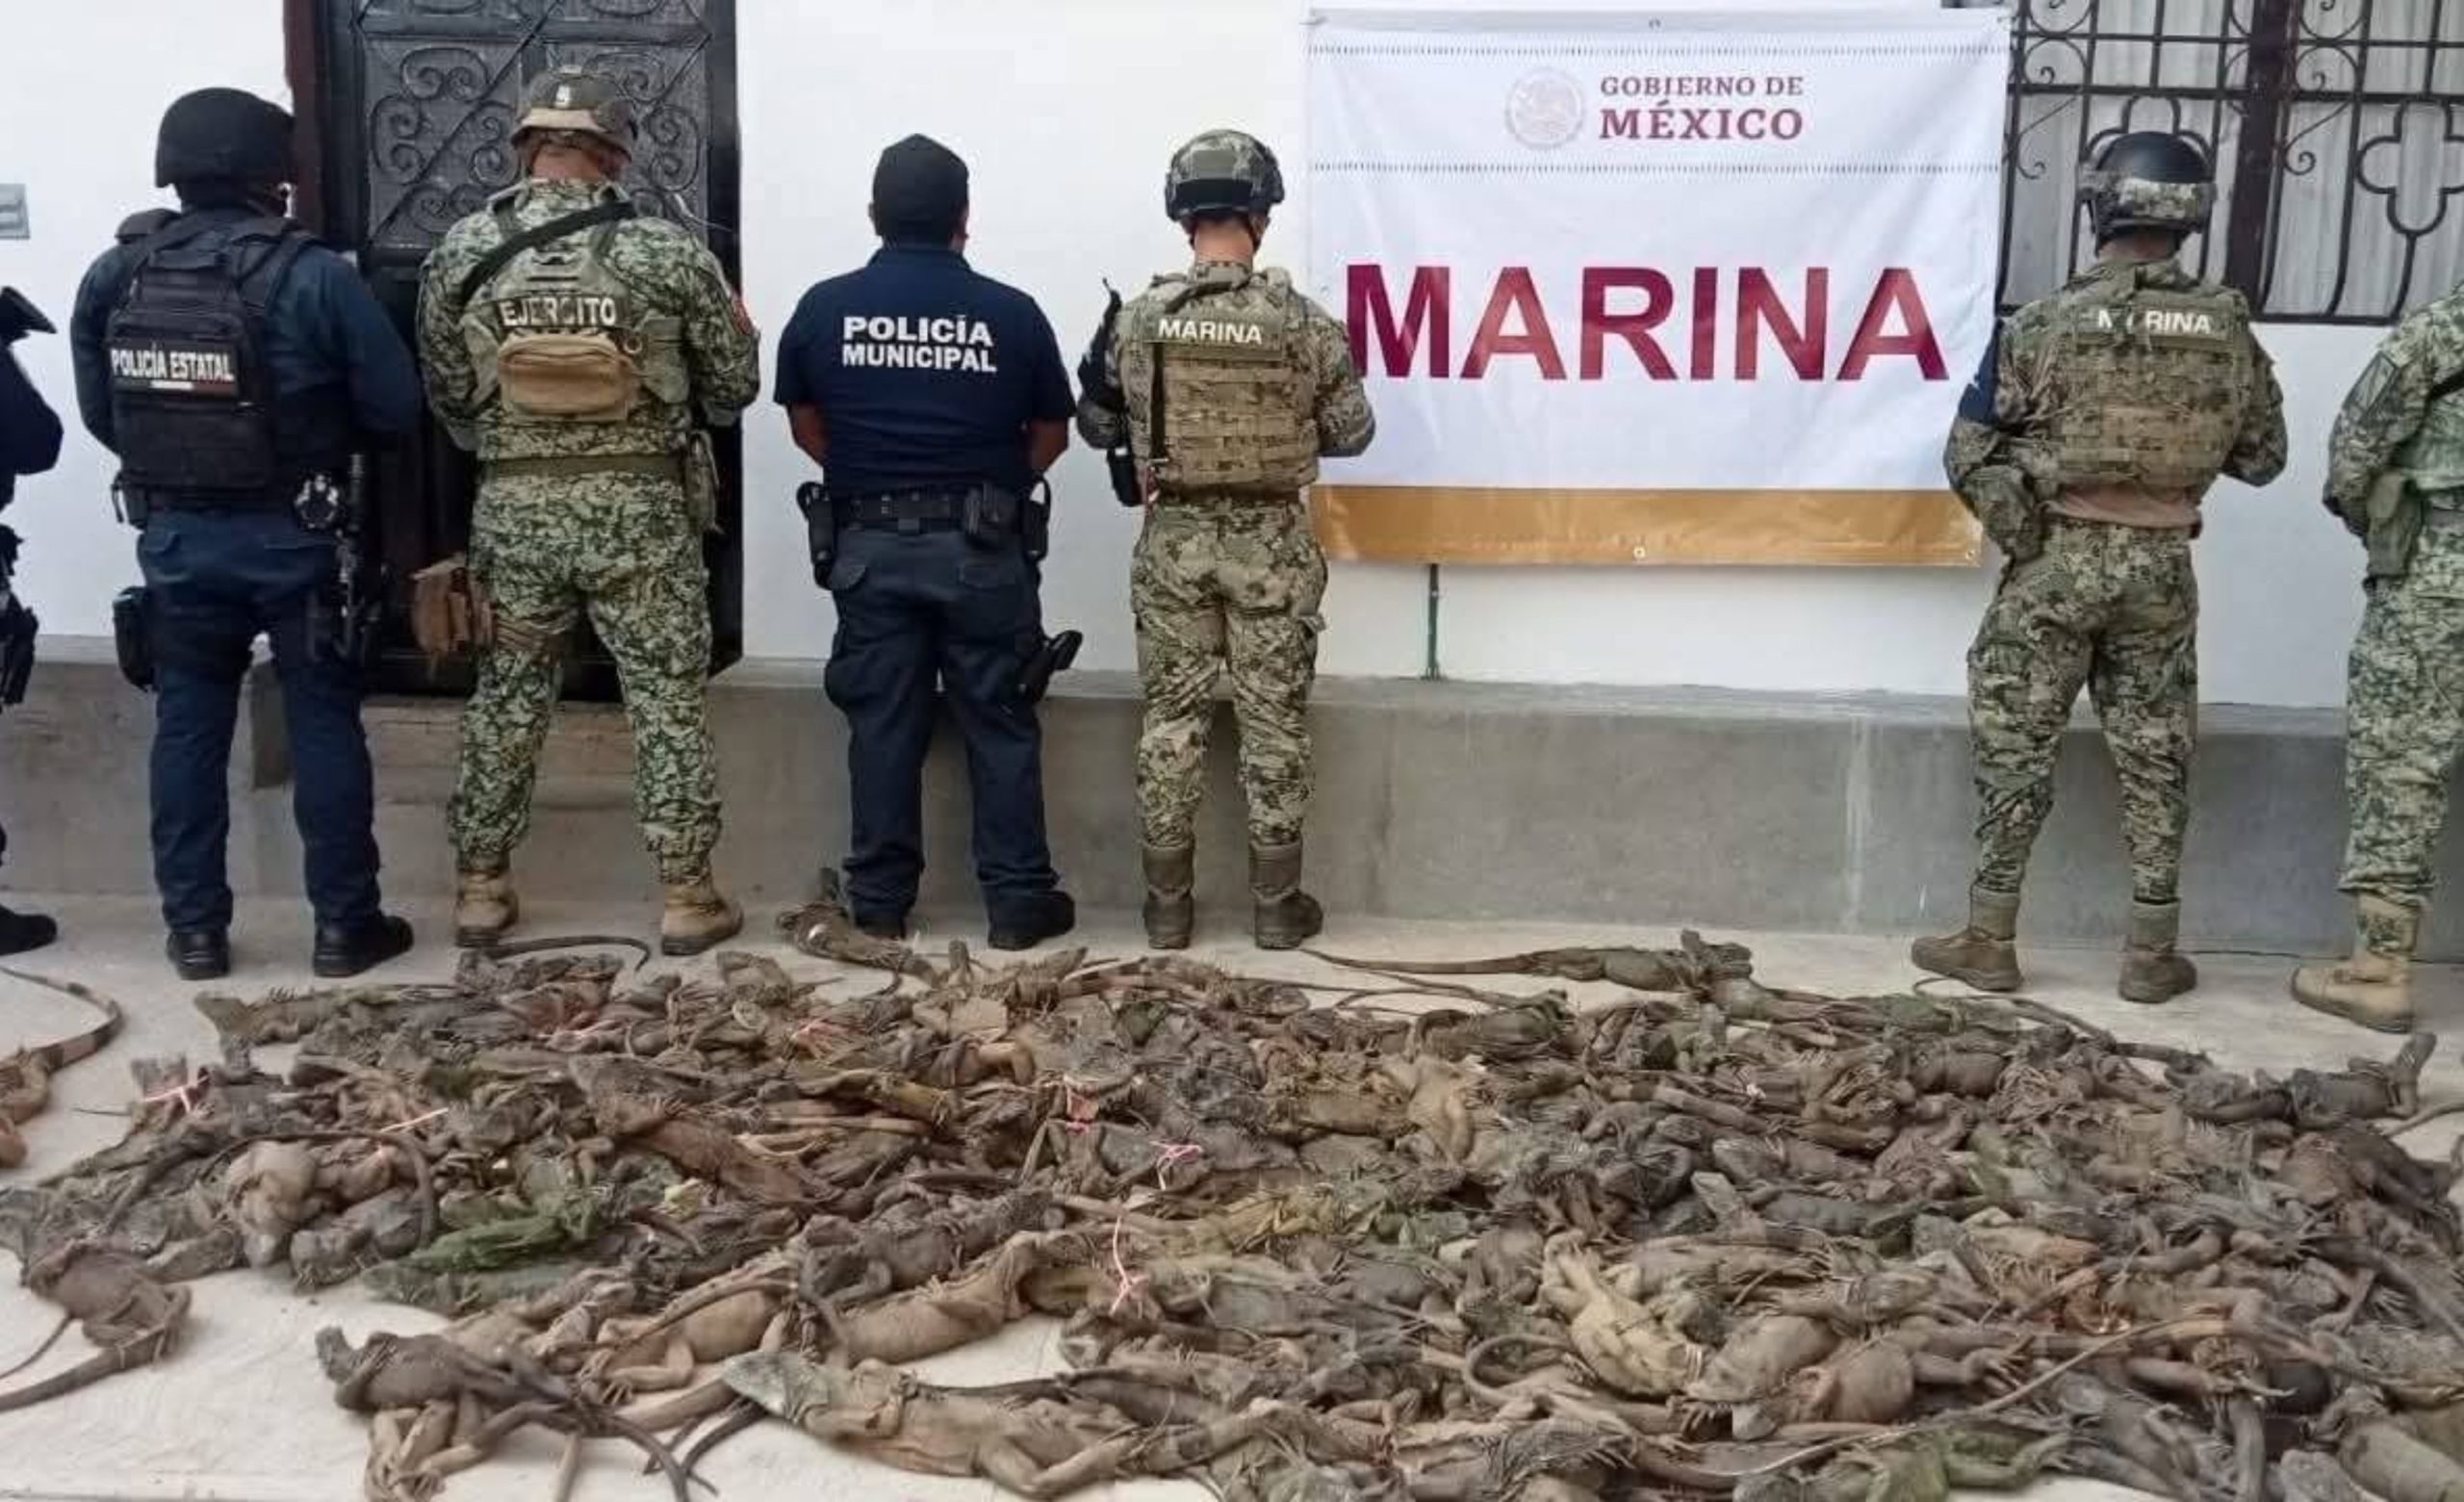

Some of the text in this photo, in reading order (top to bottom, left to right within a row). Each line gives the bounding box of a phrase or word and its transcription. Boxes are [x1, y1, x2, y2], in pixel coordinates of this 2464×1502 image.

[1600, 76, 1805, 97] GOBIERNO DE
[1599, 99, 1804, 141] MÉXICO
[1159, 318, 1262, 345] MARINA
[1348, 264, 1950, 381] MARINA
[111, 341, 235, 381] POLICÍA ESTATAL
[842, 344, 998, 373] MUNICIPAL
